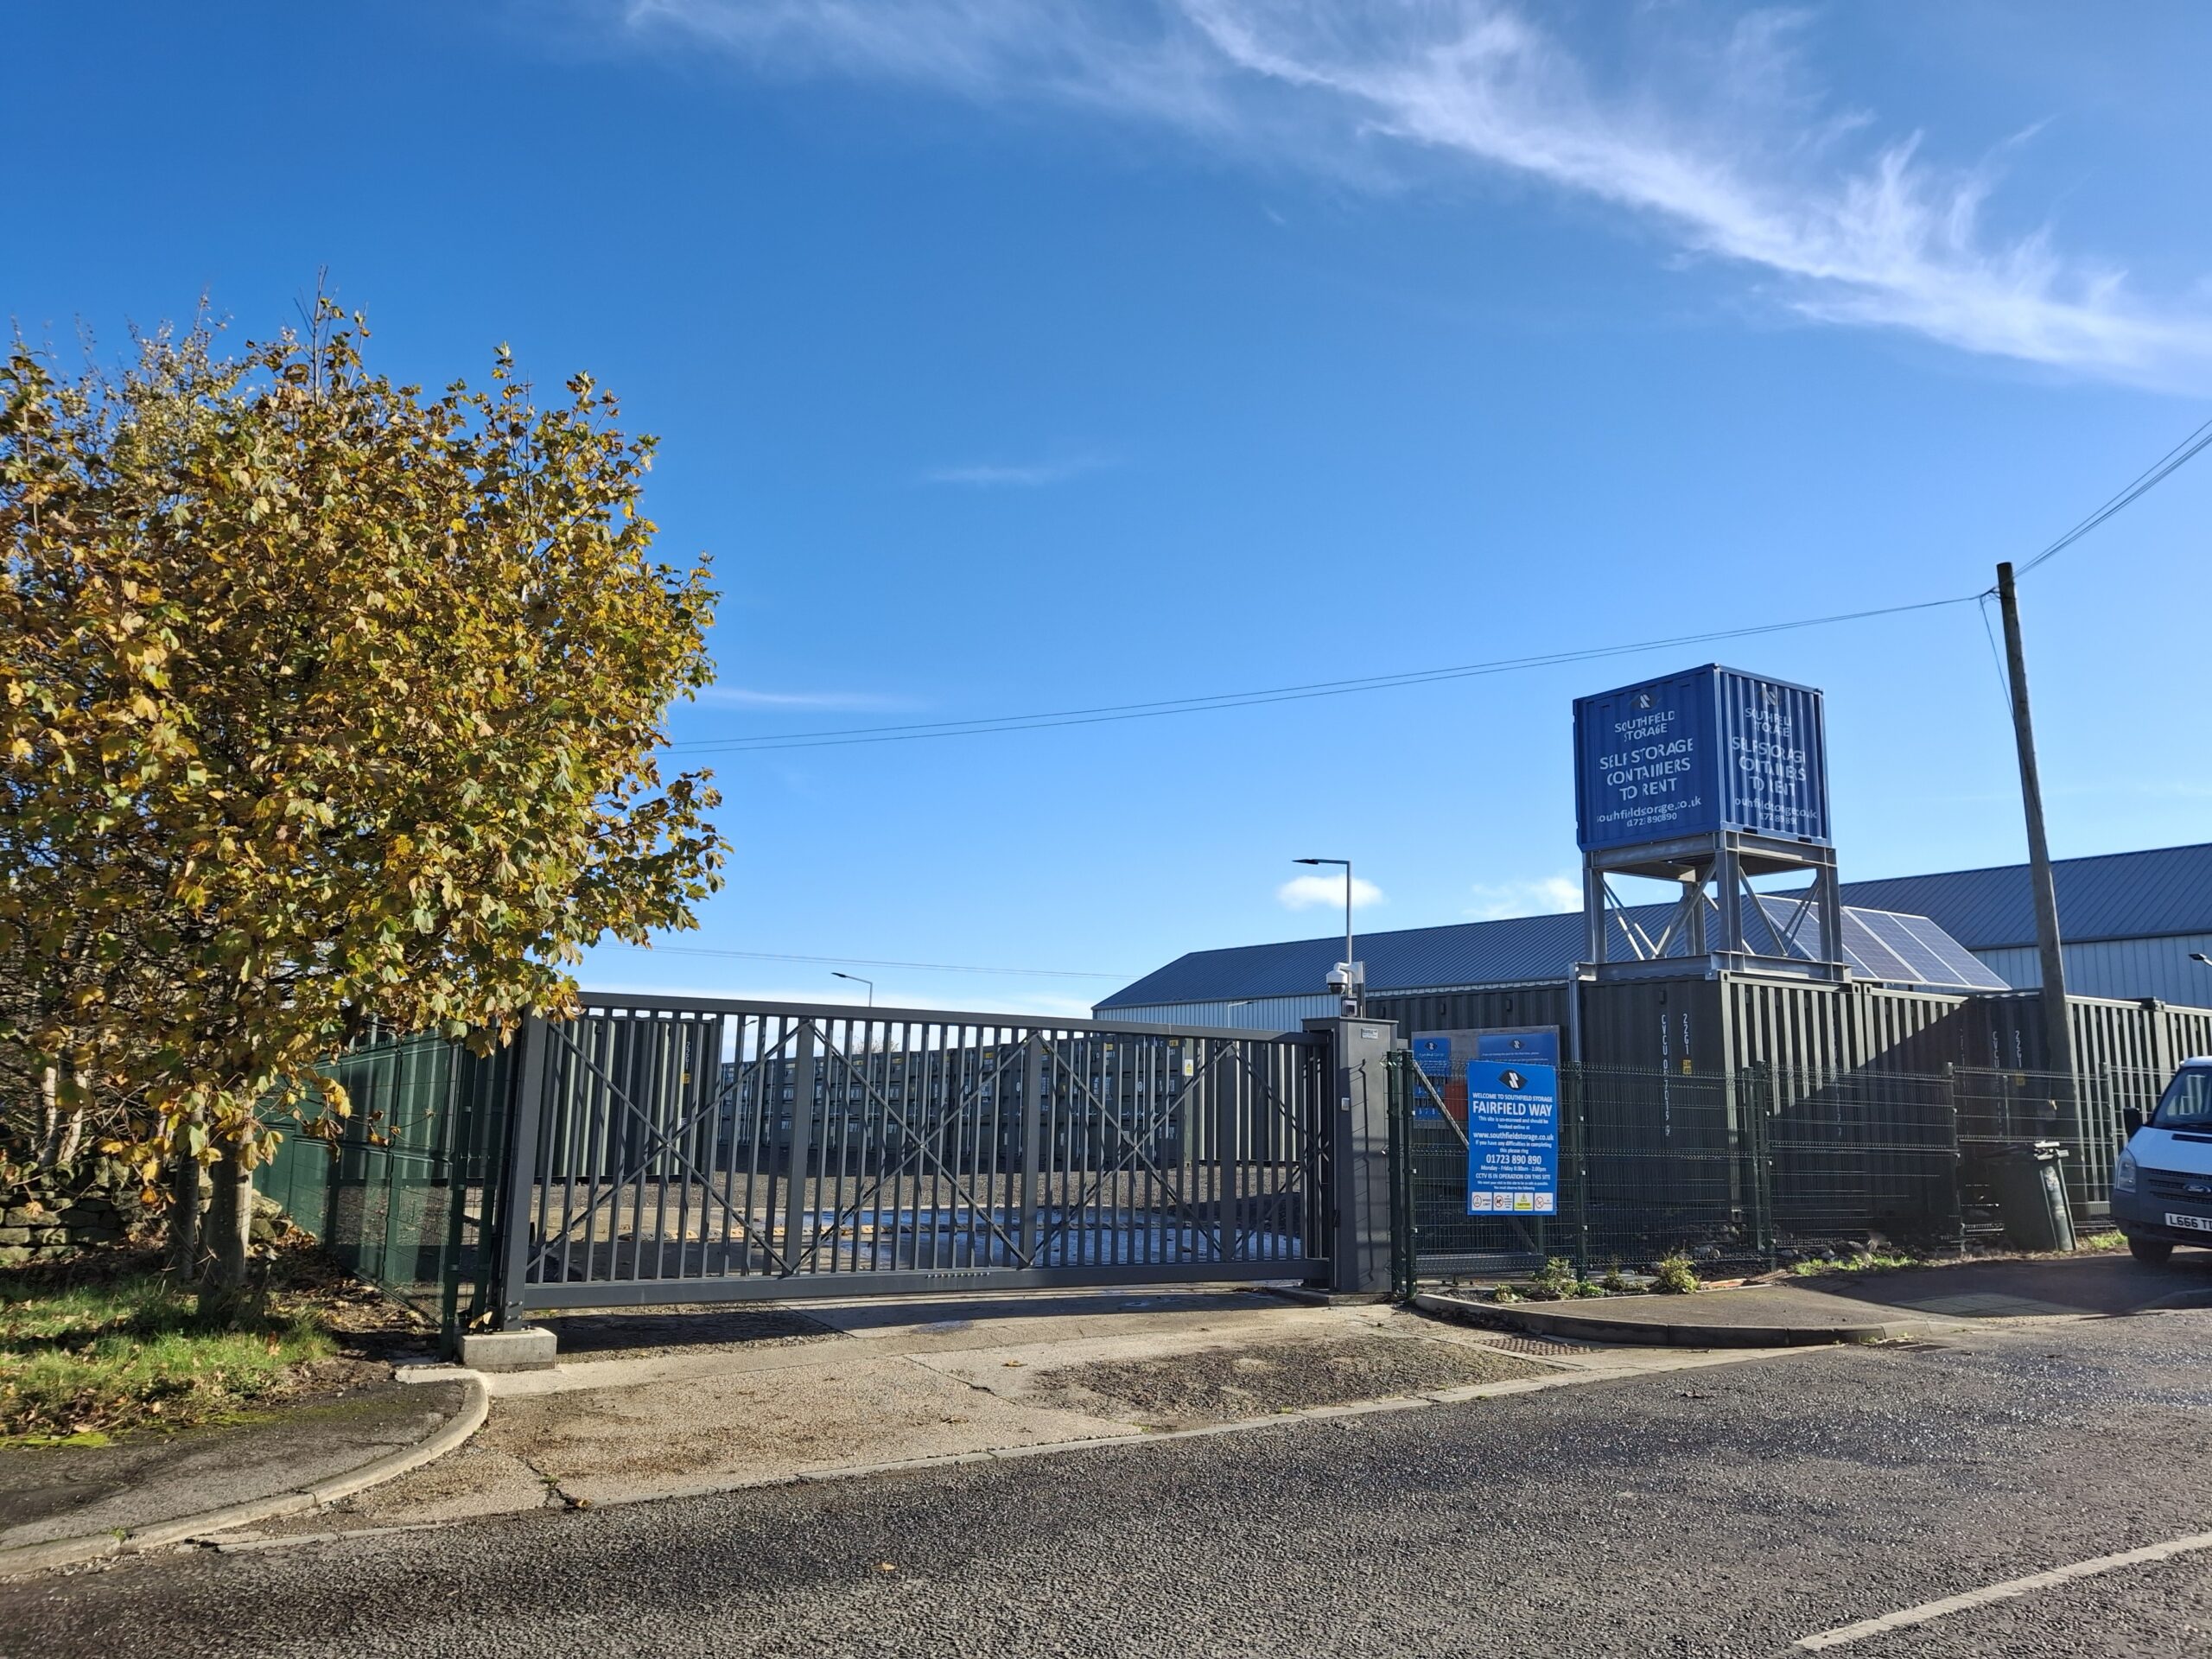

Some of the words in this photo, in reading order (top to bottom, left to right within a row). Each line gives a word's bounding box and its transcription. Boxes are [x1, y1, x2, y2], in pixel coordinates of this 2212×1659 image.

[1599, 753, 1628, 770] SELF
[1630, 738, 1694, 763] STORAGE
[1606, 757, 1691, 786] CONTAINERS
[1619, 785, 1638, 801] TO
[1642, 778, 1677, 796] RENT
[1472, 1100, 1527, 1116] FAIRFIELD
[1529, 1103, 1553, 1117] WAY
[1472, 1131, 1554, 1141] www.southfieldstorage.co.uk
[1486, 1154, 1510, 1164] 01723
[1511, 1154, 1526, 1165] 890
[1528, 1155, 1541, 1165] 890
[2169, 1215, 2198, 1228] L666
